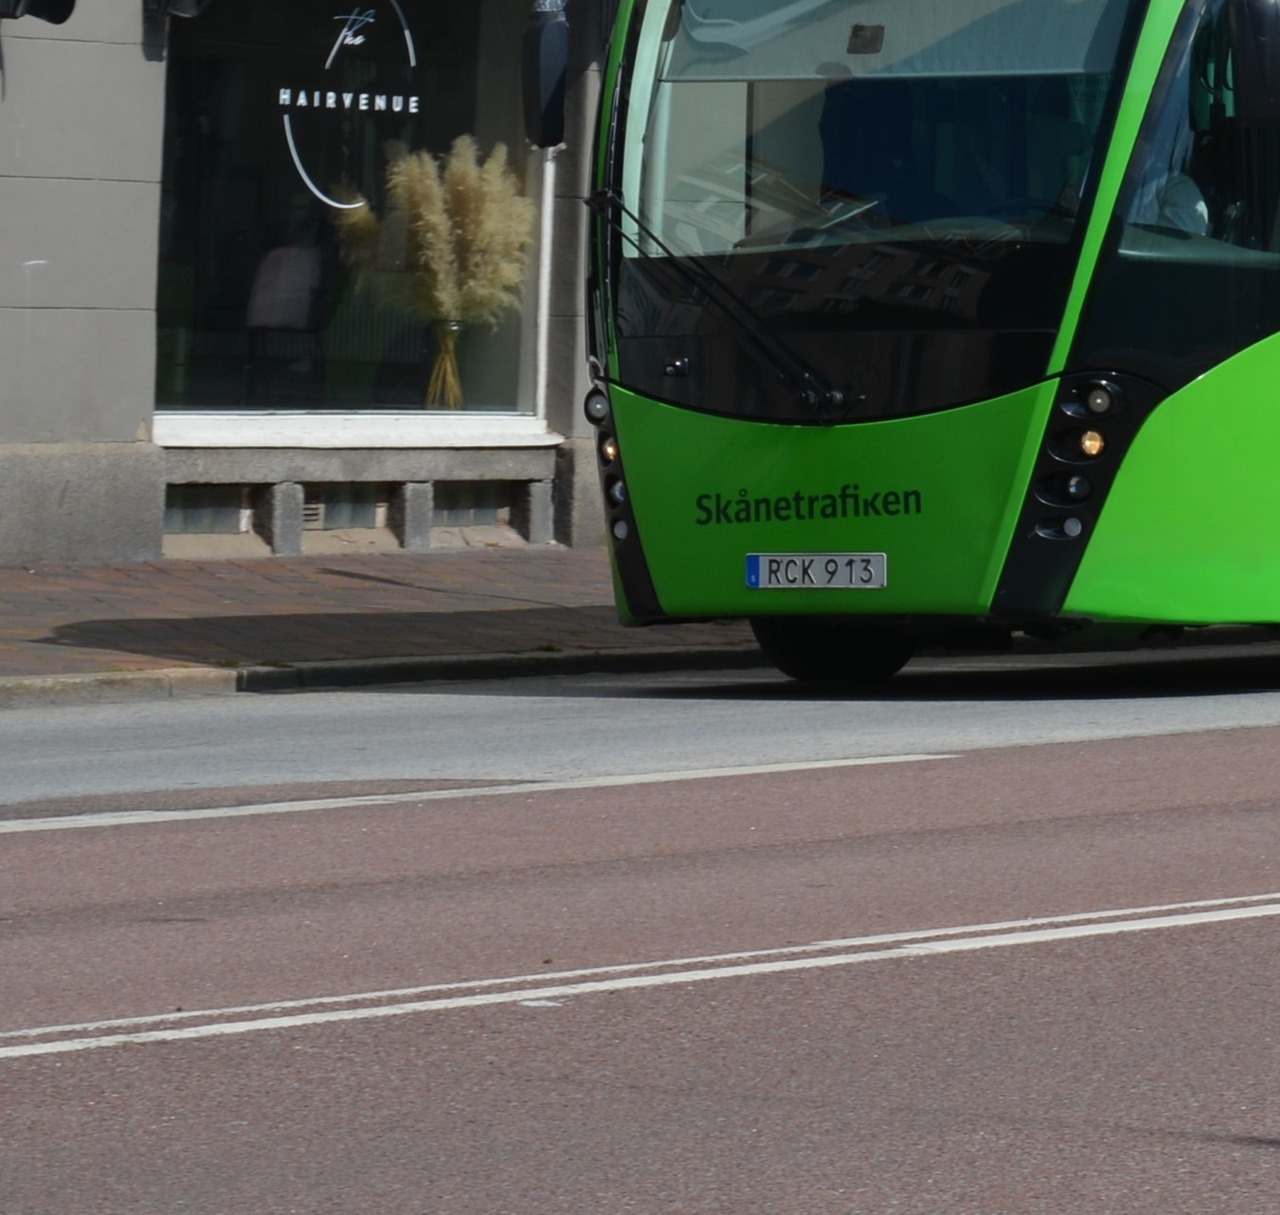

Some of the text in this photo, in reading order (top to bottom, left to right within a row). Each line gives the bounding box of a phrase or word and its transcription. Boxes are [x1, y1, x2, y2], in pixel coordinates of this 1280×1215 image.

[278, 87, 421, 114] HAIRVENUE
[694, 484, 923, 526] Skånetrafiken
[768, 558, 875, 584] RCK 913
